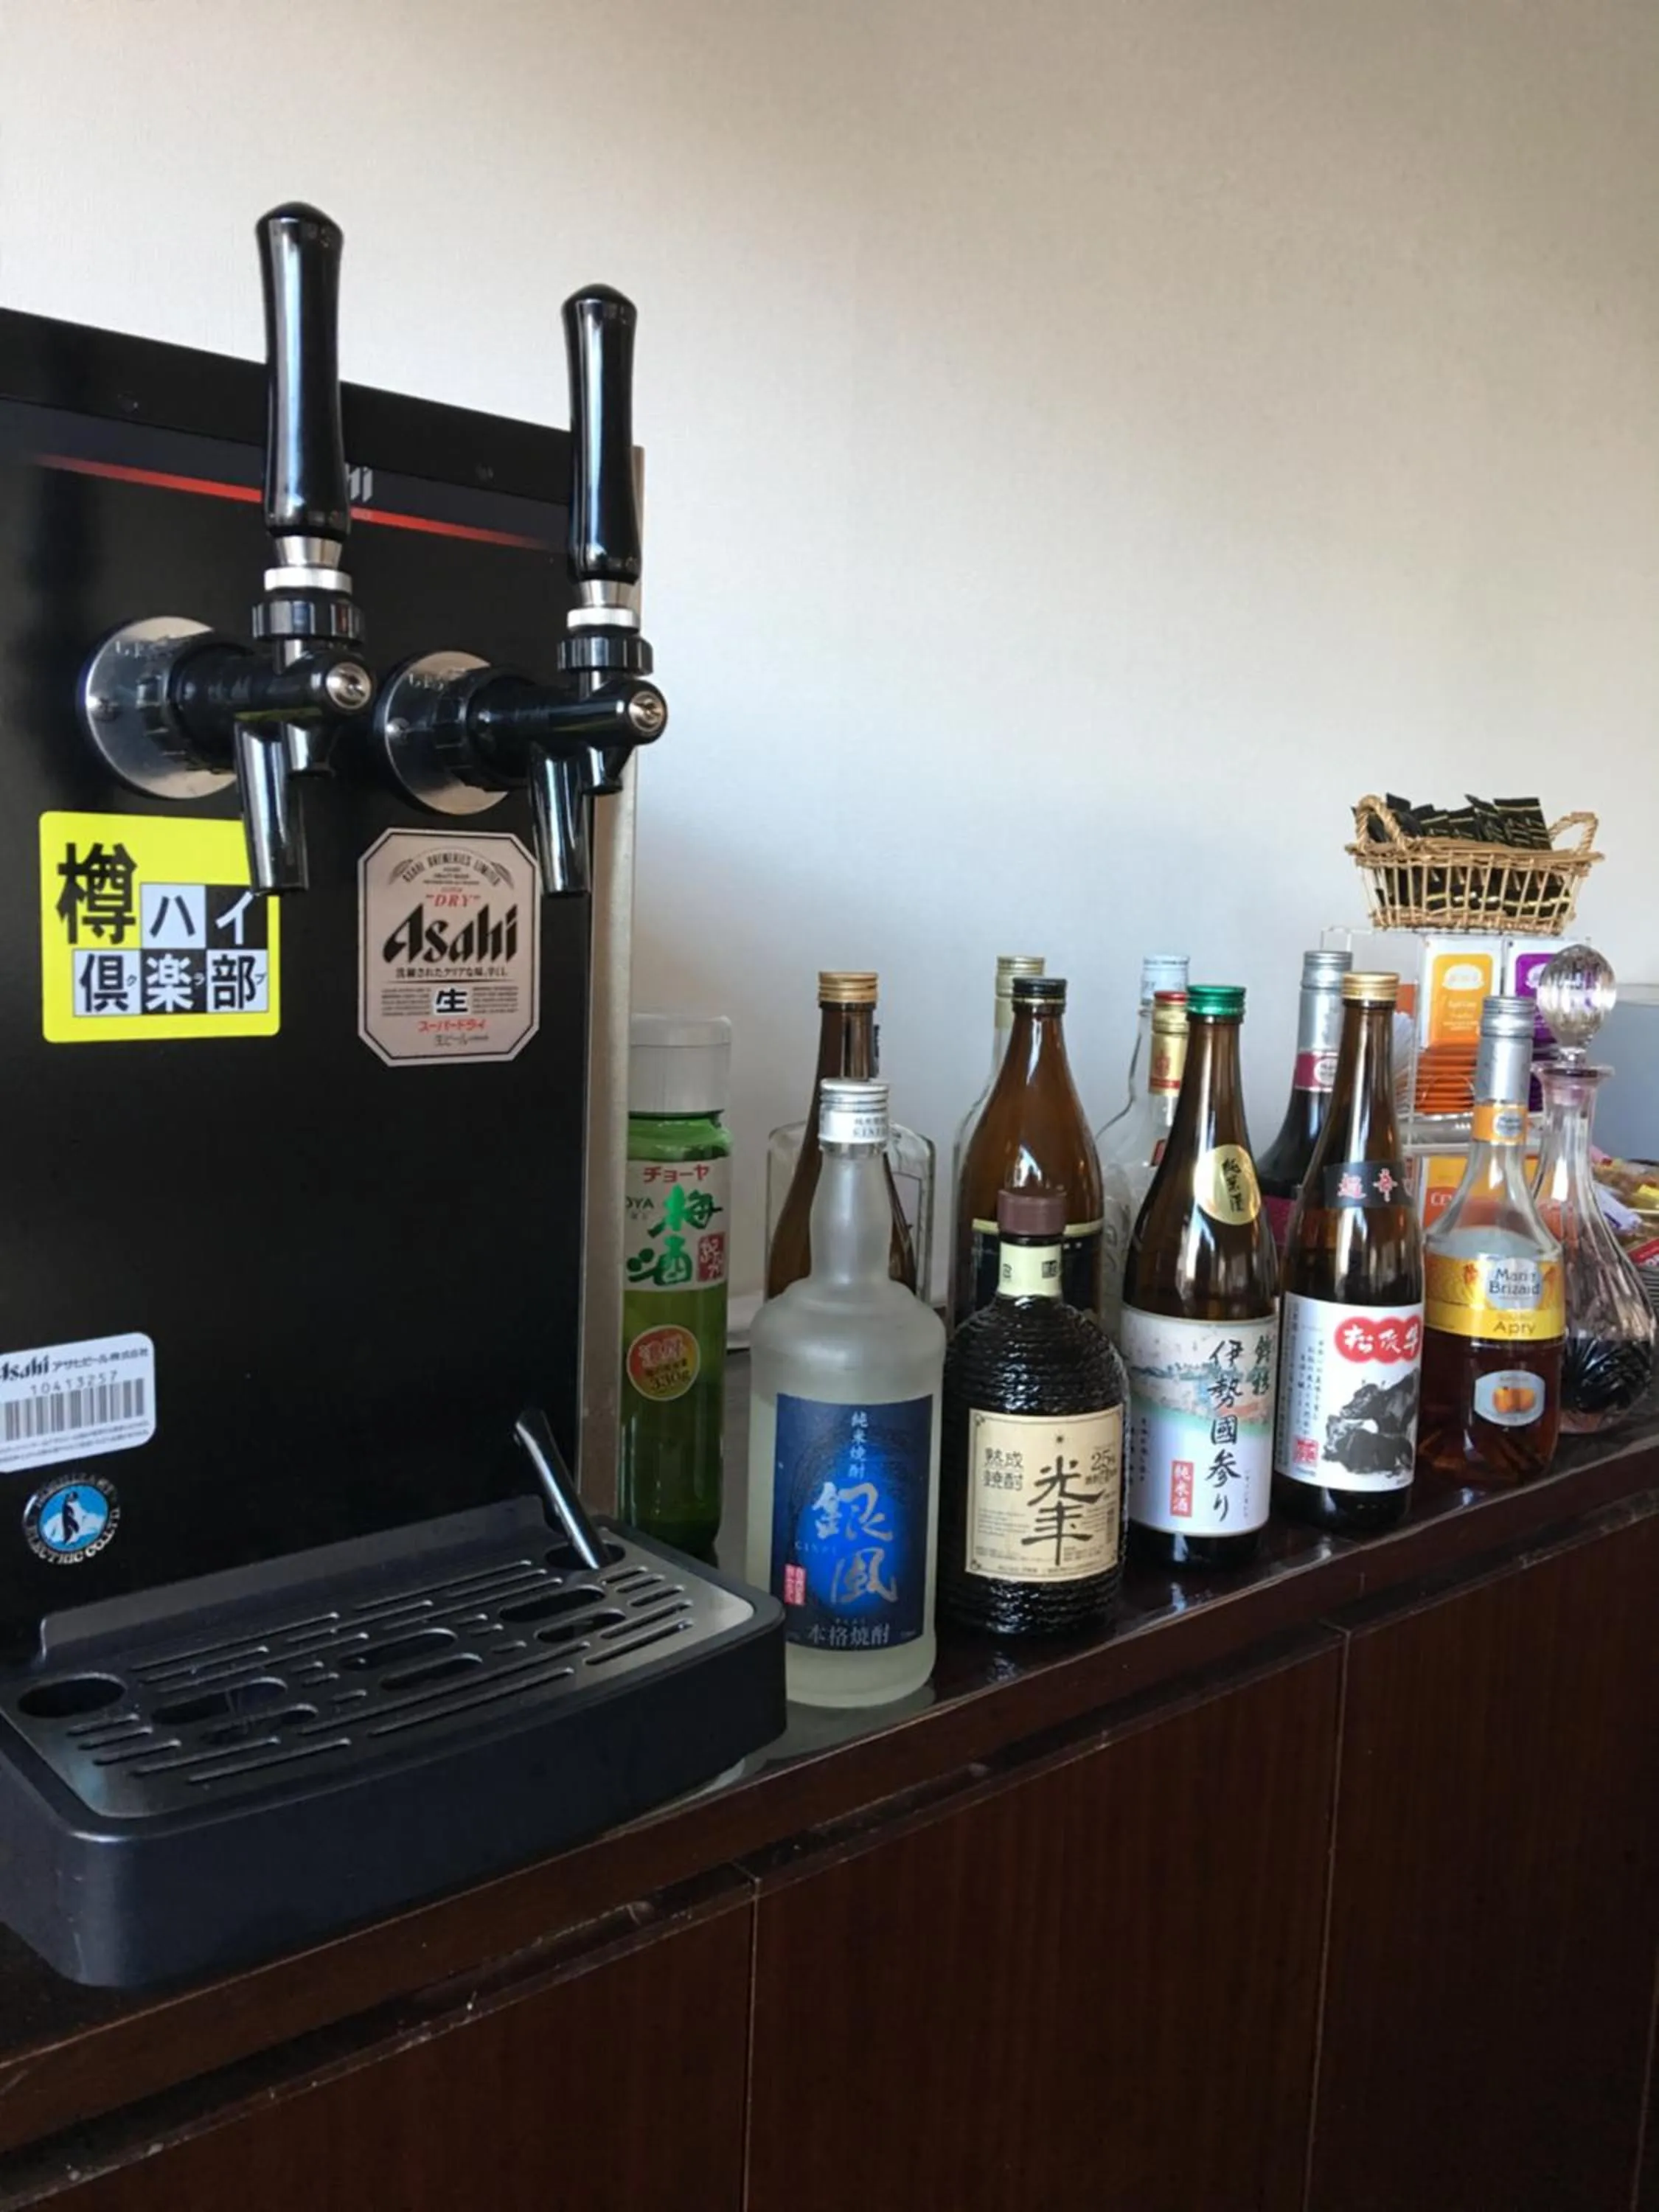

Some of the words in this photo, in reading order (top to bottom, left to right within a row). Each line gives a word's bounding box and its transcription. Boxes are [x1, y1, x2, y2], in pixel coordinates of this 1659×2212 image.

[382, 903, 518, 964] Asahi
[79, 953, 257, 1012] 倶楽部
[436, 988, 468, 1013] 生
[418, 1018, 487, 1032] スーパードライ
[643, 1164, 709, 1184] チョーヤ
